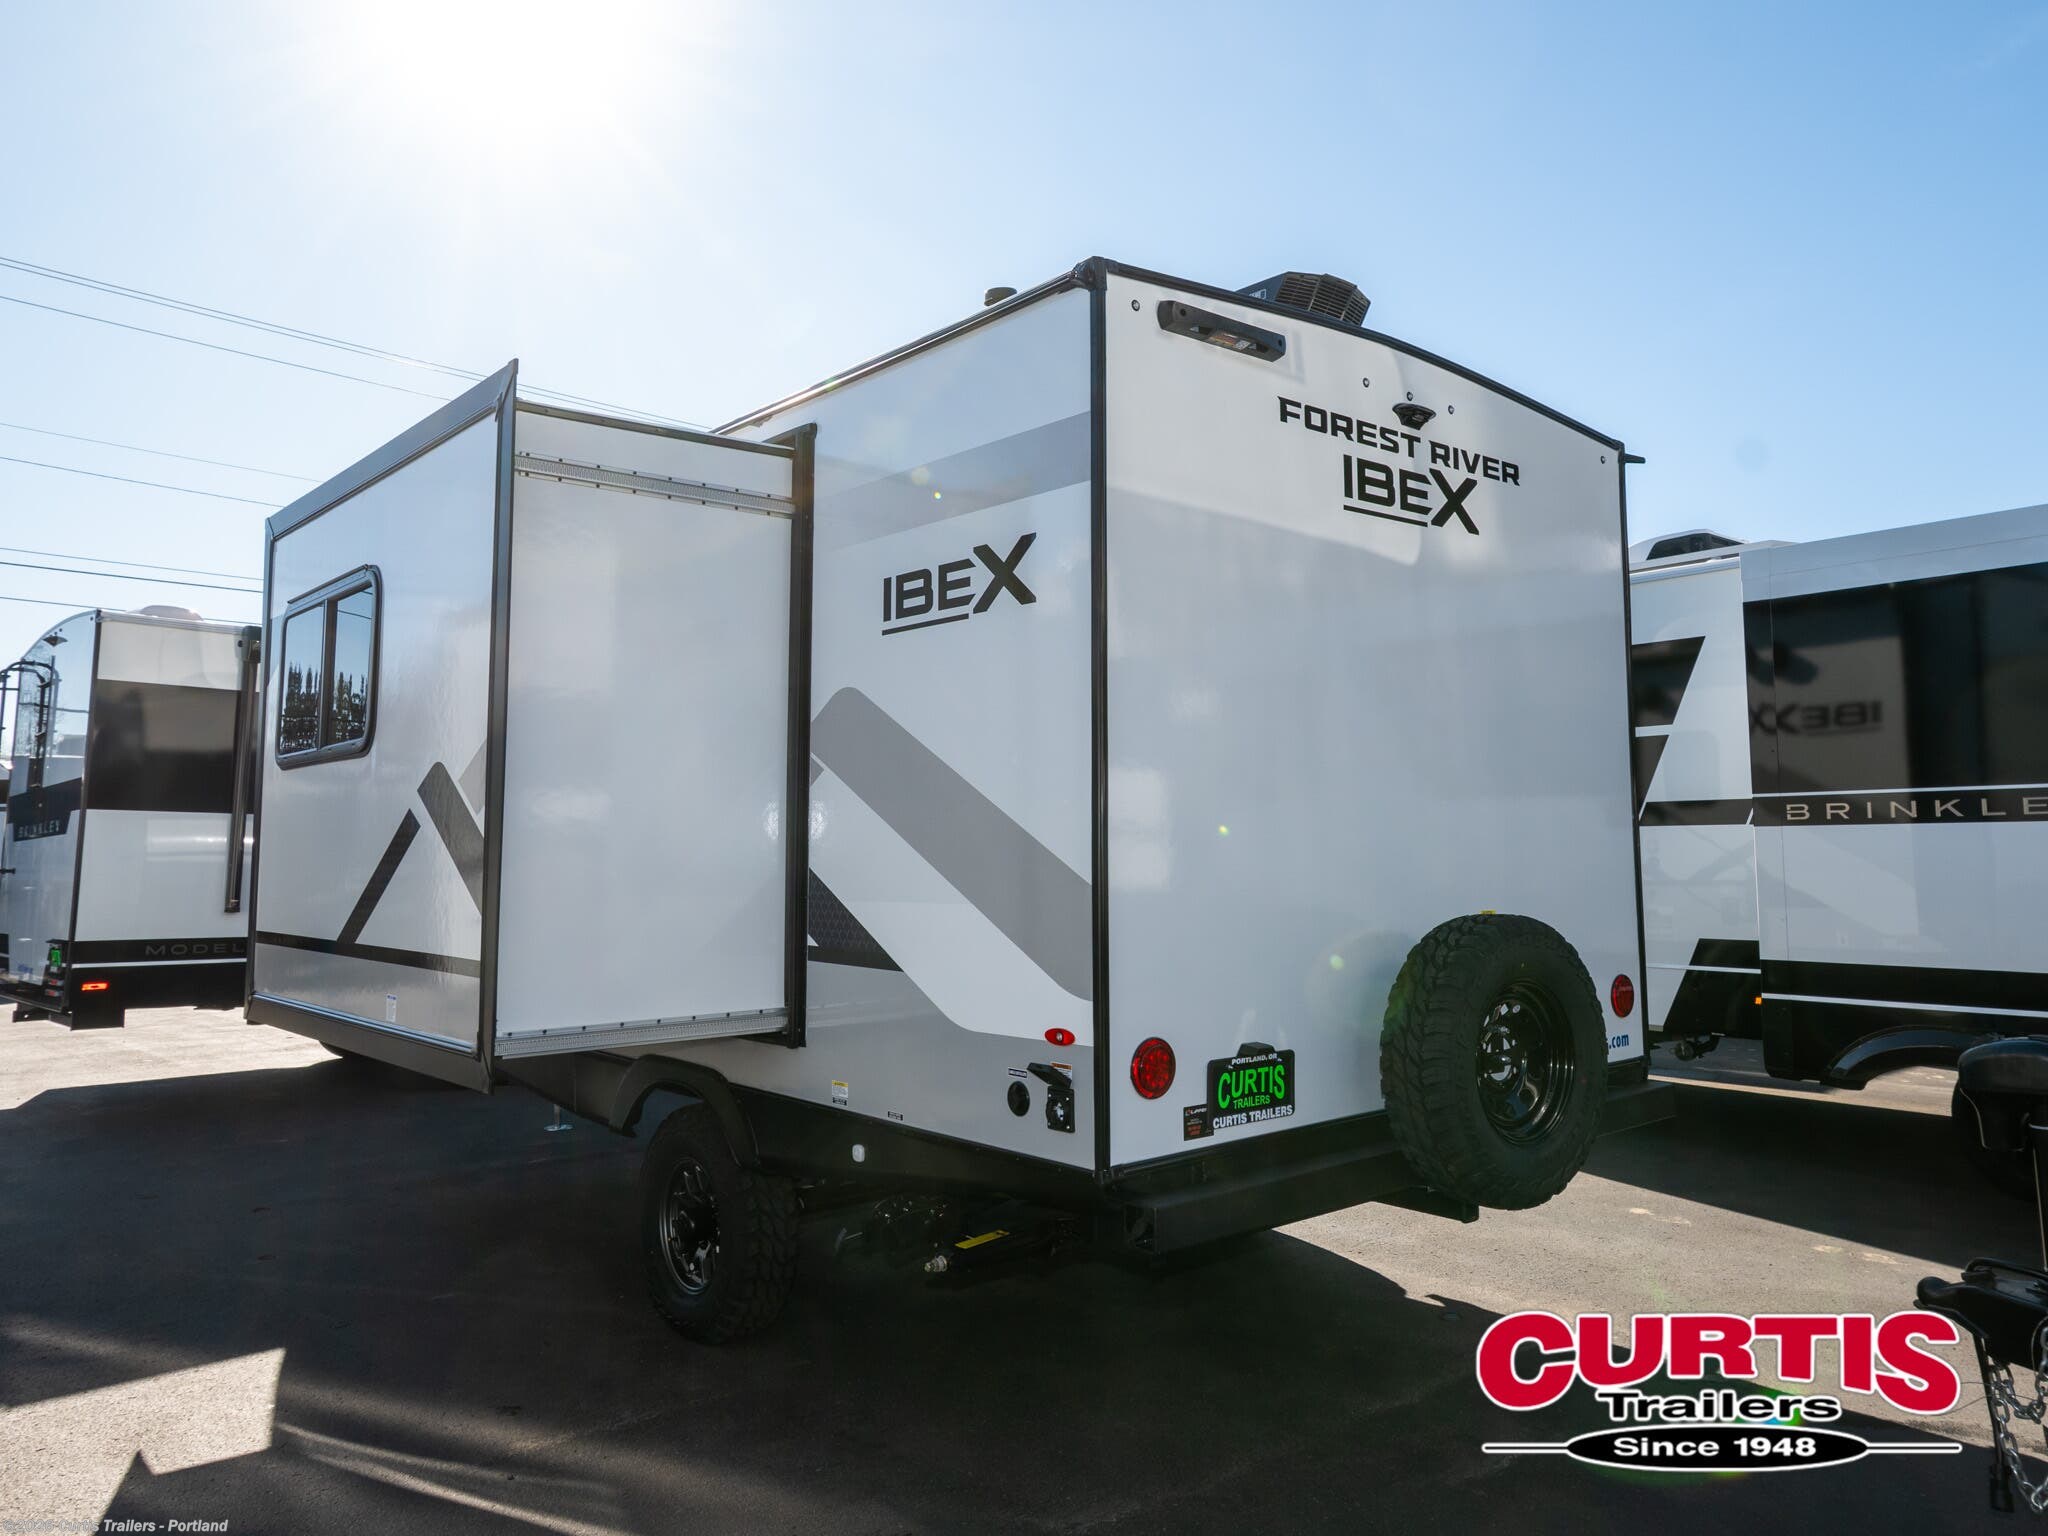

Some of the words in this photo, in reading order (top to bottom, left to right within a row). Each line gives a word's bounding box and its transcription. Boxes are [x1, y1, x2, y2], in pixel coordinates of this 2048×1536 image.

[1277, 396, 1421, 458] FOREST
[1429, 440, 1520, 486] RIVER
[1343, 454, 1479, 535] IBEX
[883, 532, 1037, 622] IBEX
[1786, 796, 2048, 821] BRINKLE
[145, 943, 246, 957] MODEL
[1217, 1064, 1285, 1109] CURTIS
[1232, 1095, 1271, 1110] TRAILERS
[1212, 1112, 1247, 1129] CURTIS
[1249, 1104, 1293, 1122] TRAILERS
